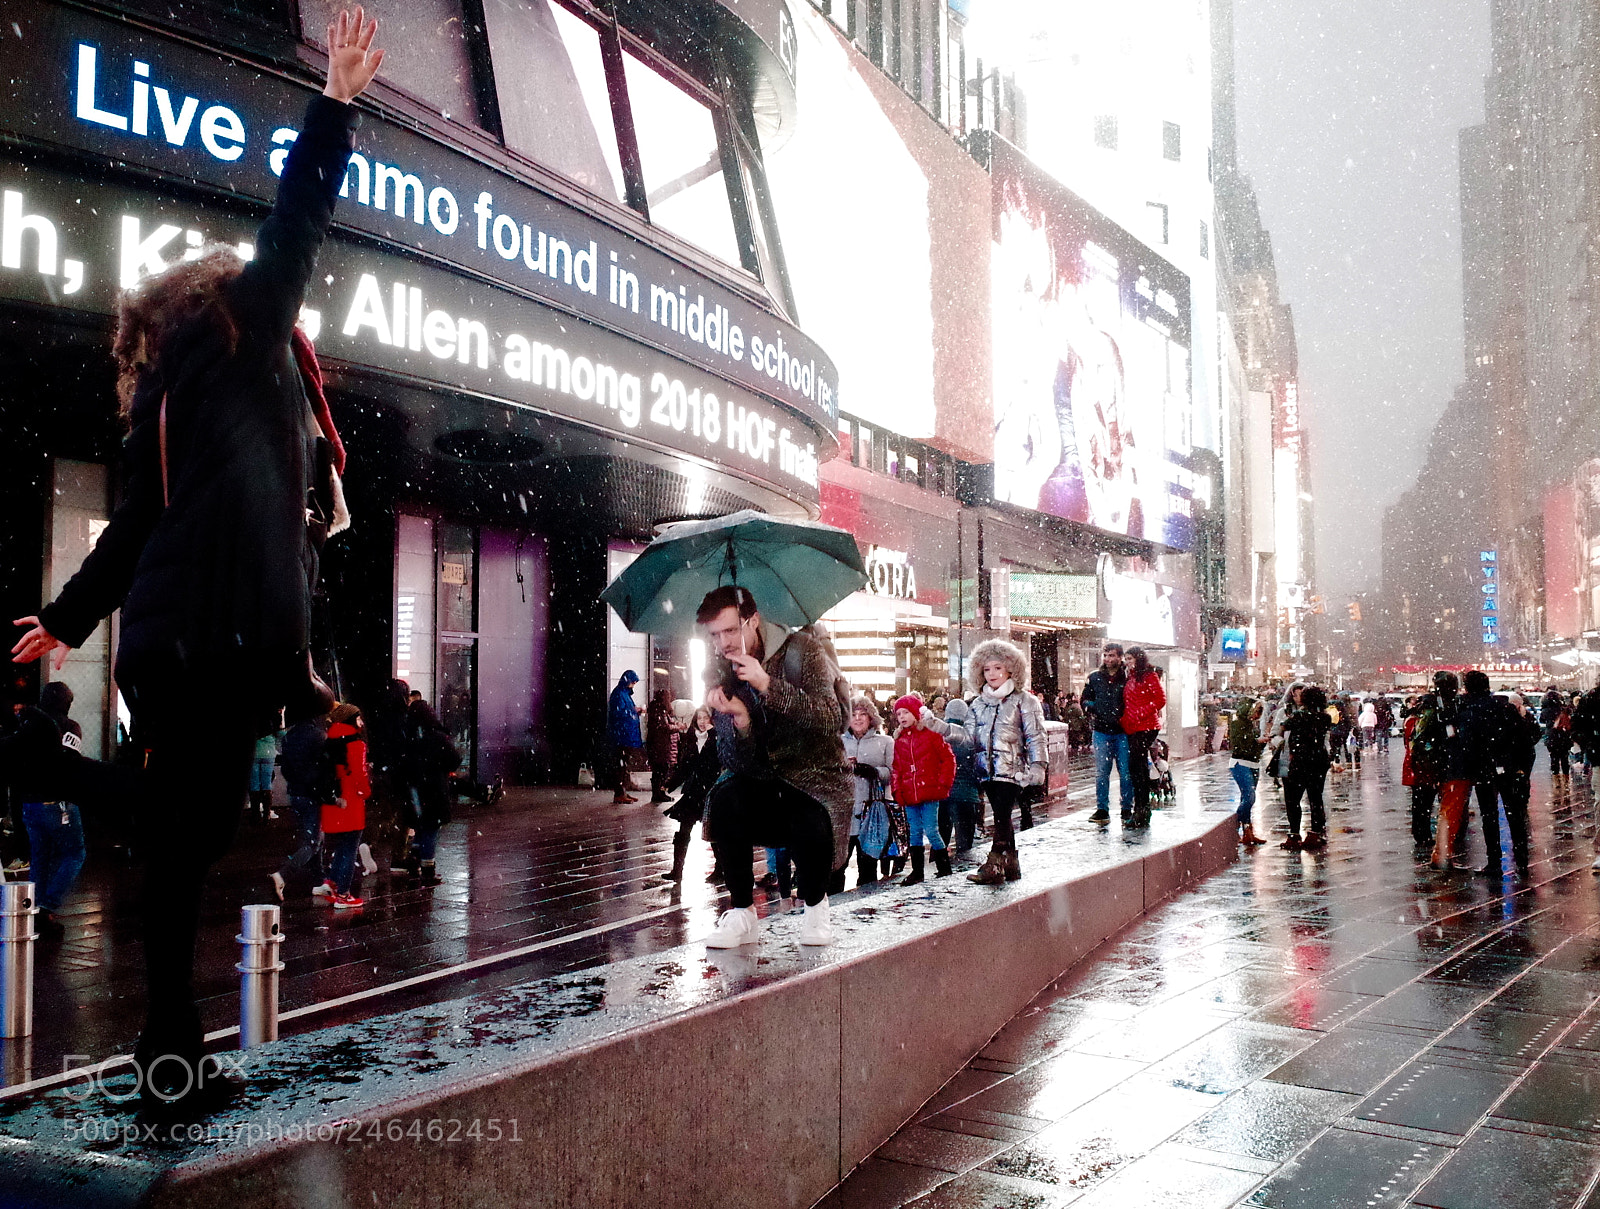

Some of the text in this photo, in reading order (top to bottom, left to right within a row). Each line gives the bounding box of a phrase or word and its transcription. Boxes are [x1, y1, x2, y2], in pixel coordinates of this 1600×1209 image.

[76, 43, 246, 161] Live
[474, 191, 598, 295] found
[609, 251, 639, 313] in
[650, 283, 745, 360] middle
[751, 335, 815, 401] school
[343, 273, 489, 369] Allen
[504, 333, 641, 427] among
[650, 373, 721, 443] 2018
[727, 401, 776, 463] HOF
